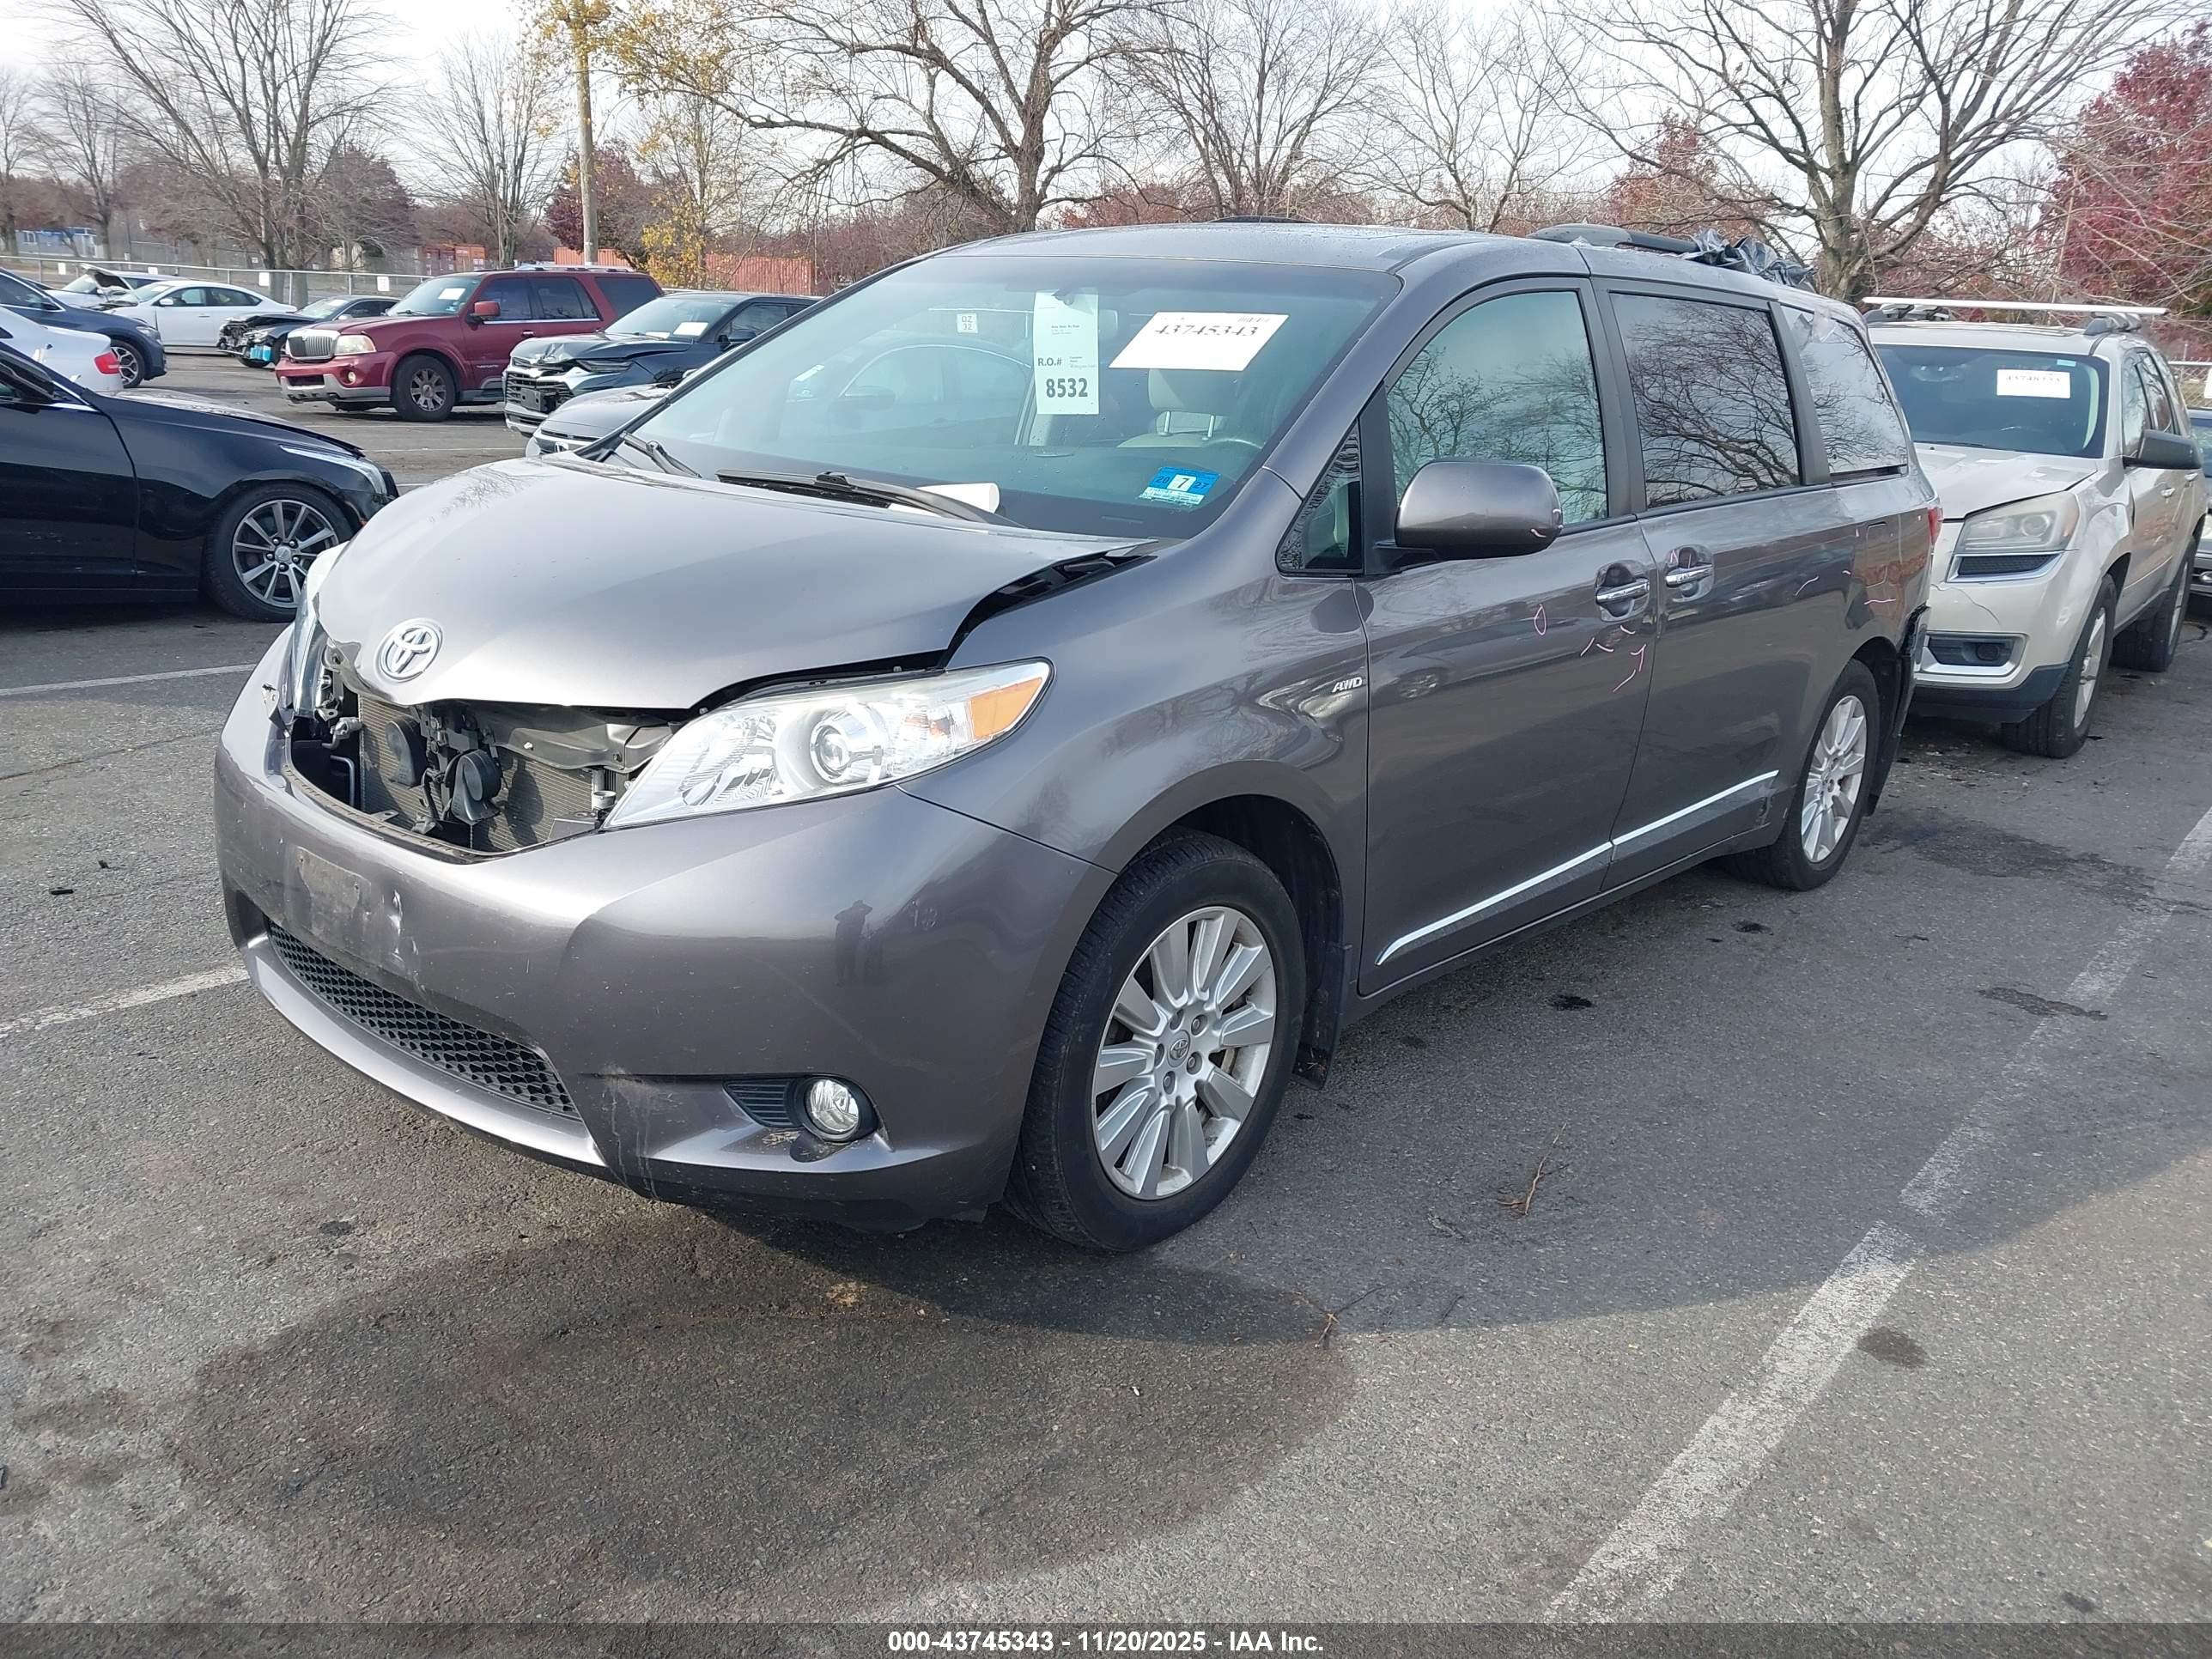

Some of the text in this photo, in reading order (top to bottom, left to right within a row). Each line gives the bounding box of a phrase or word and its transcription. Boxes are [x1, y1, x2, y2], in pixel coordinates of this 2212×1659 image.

[1154, 325, 1258, 337] 43745343
[1037, 357, 1062, 367] R.O.#
[1046, 378, 1088, 398] 8532
[1154, 475, 1170, 483] 20
[1177, 477, 1190, 489] 7
[1332, 677, 1363, 693] AWD
